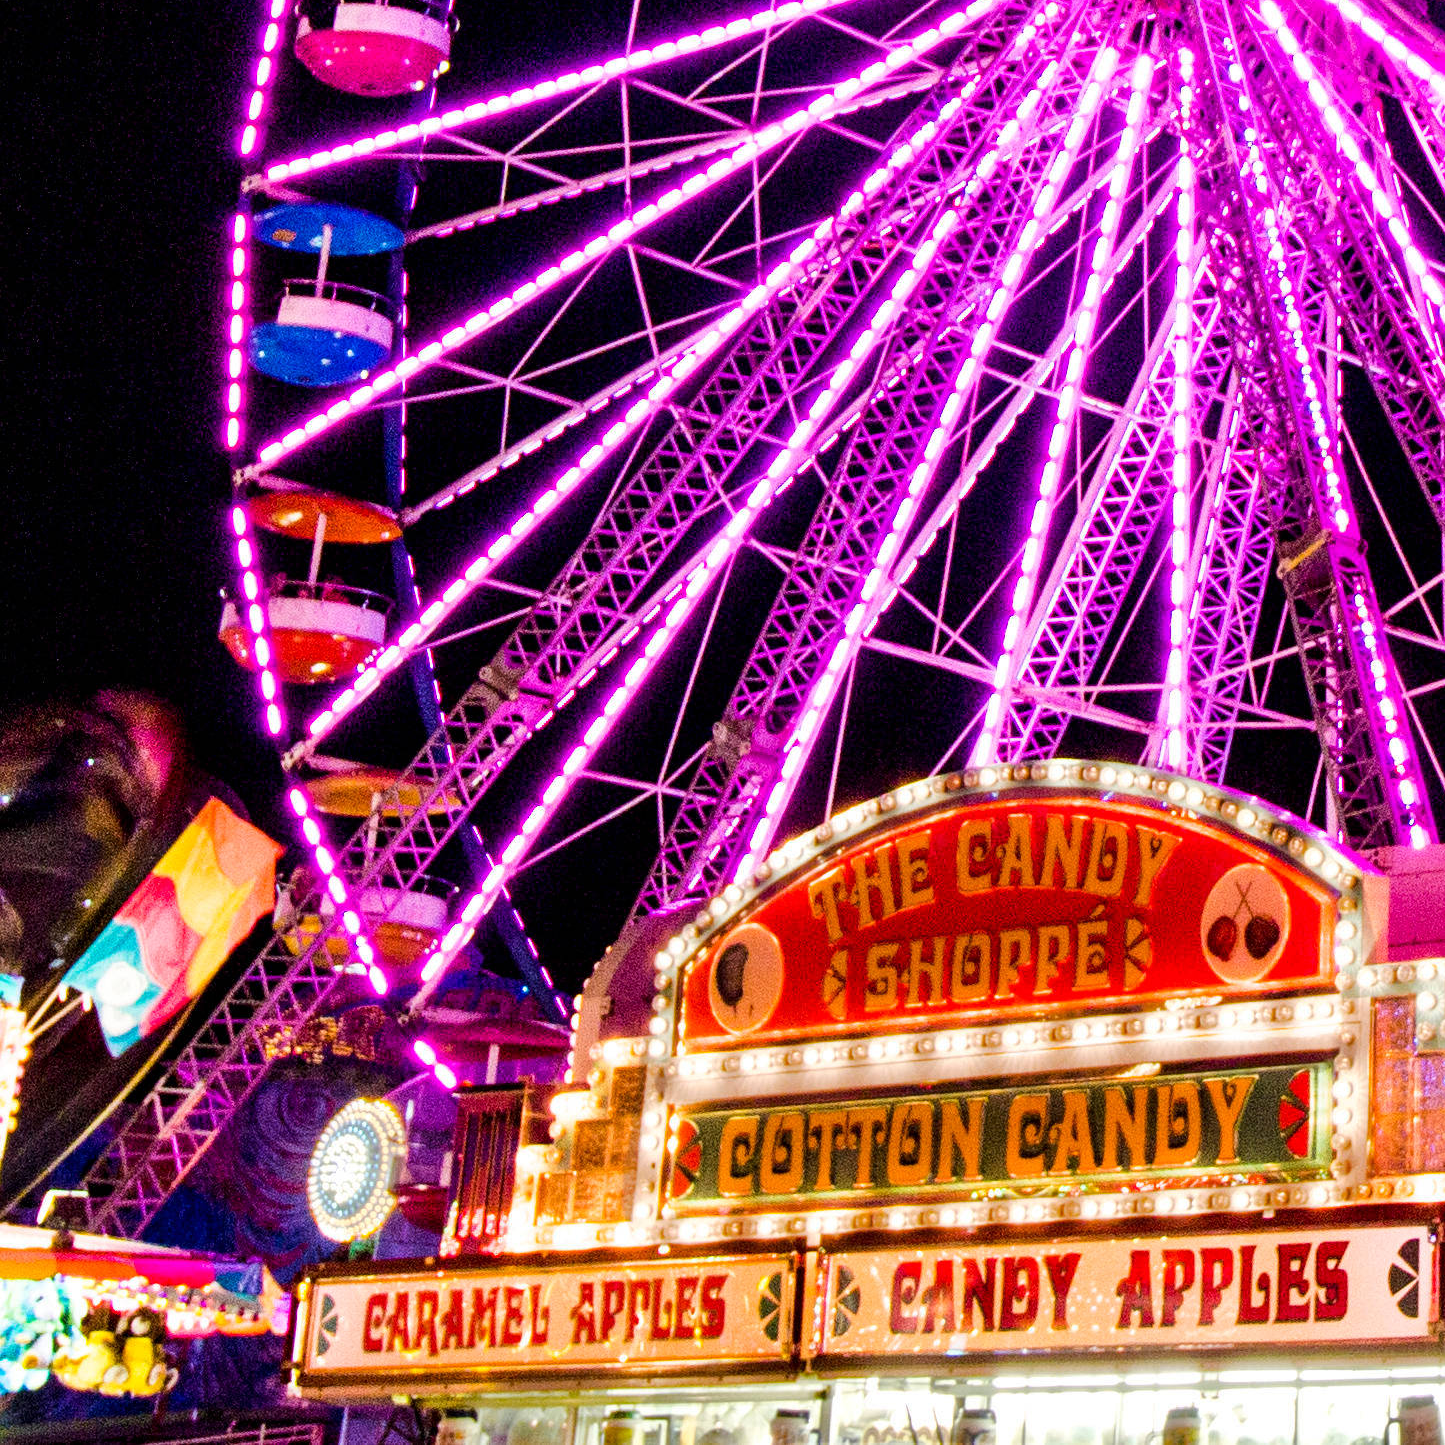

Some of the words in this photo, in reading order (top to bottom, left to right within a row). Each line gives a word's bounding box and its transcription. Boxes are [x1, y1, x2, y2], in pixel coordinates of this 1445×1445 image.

[809, 829, 936, 945] THE
[957, 813, 1183, 909] CANDY
[864, 905, 1111, 1011] SHOPPÉ
[717, 1096, 989, 1198] COTTON
[1006, 1074, 1259, 1181] CANDY
[362, 1283, 549, 1355] CARAMEL
[570, 1273, 729, 1345] APPLES
[889, 1252, 1083, 1335] CANDY
[1115, 1241, 1350, 1330] APPLES
